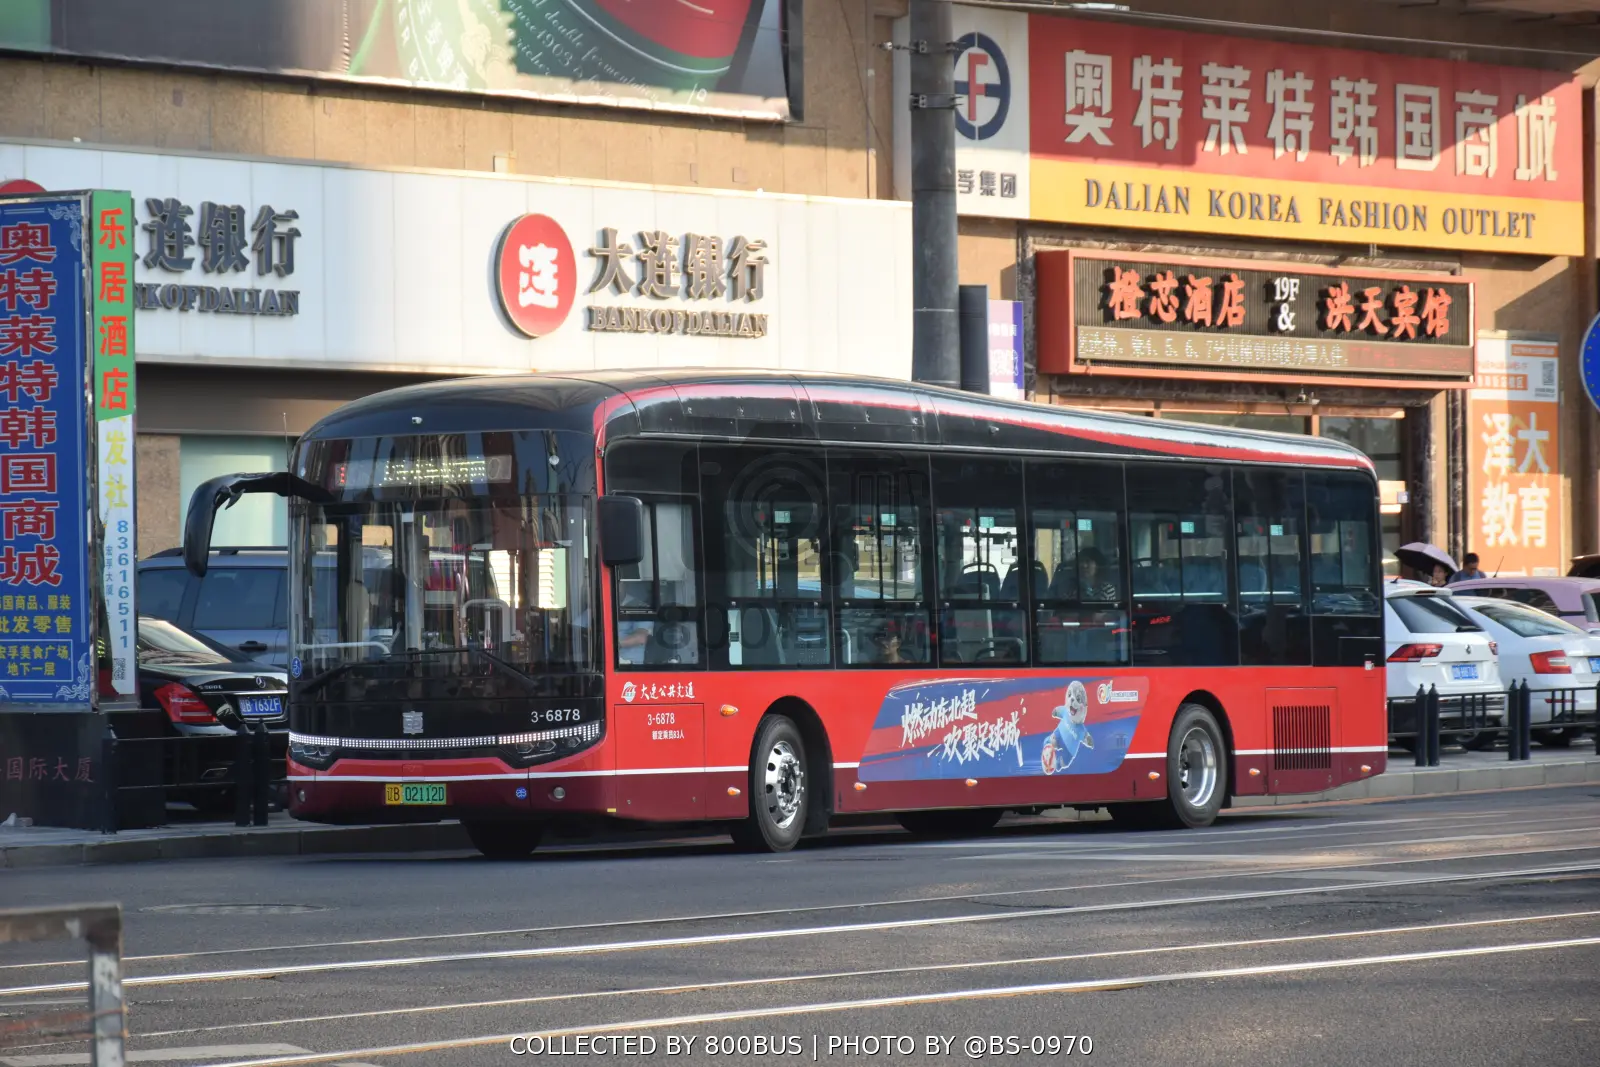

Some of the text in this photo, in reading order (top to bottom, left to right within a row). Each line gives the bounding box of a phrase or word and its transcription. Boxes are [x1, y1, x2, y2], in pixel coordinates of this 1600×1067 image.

[1064, 49, 1558, 182] 奥特莱特韩国商城
[134, 197, 302, 277] 连银行
[1085, 178, 1537, 239] DALIAN KOREA FASHION OUTLET
[587, 227, 770, 302] 大连银行
[1274, 277, 1300, 301] 19F
[98, 207, 128, 411] 乐居酒店
[1109, 266, 1246, 327] 橙芯酒店
[1277, 303, 1296, 331] &
[1326, 281, 1452, 339] 洪天宾馆
[0, 594, 71, 611] 国商品、服装
[117, 520, 130, 648] 83616511
[531, 709, 581, 723] 3-6878
[648, 713, 675, 726] 3-6878
